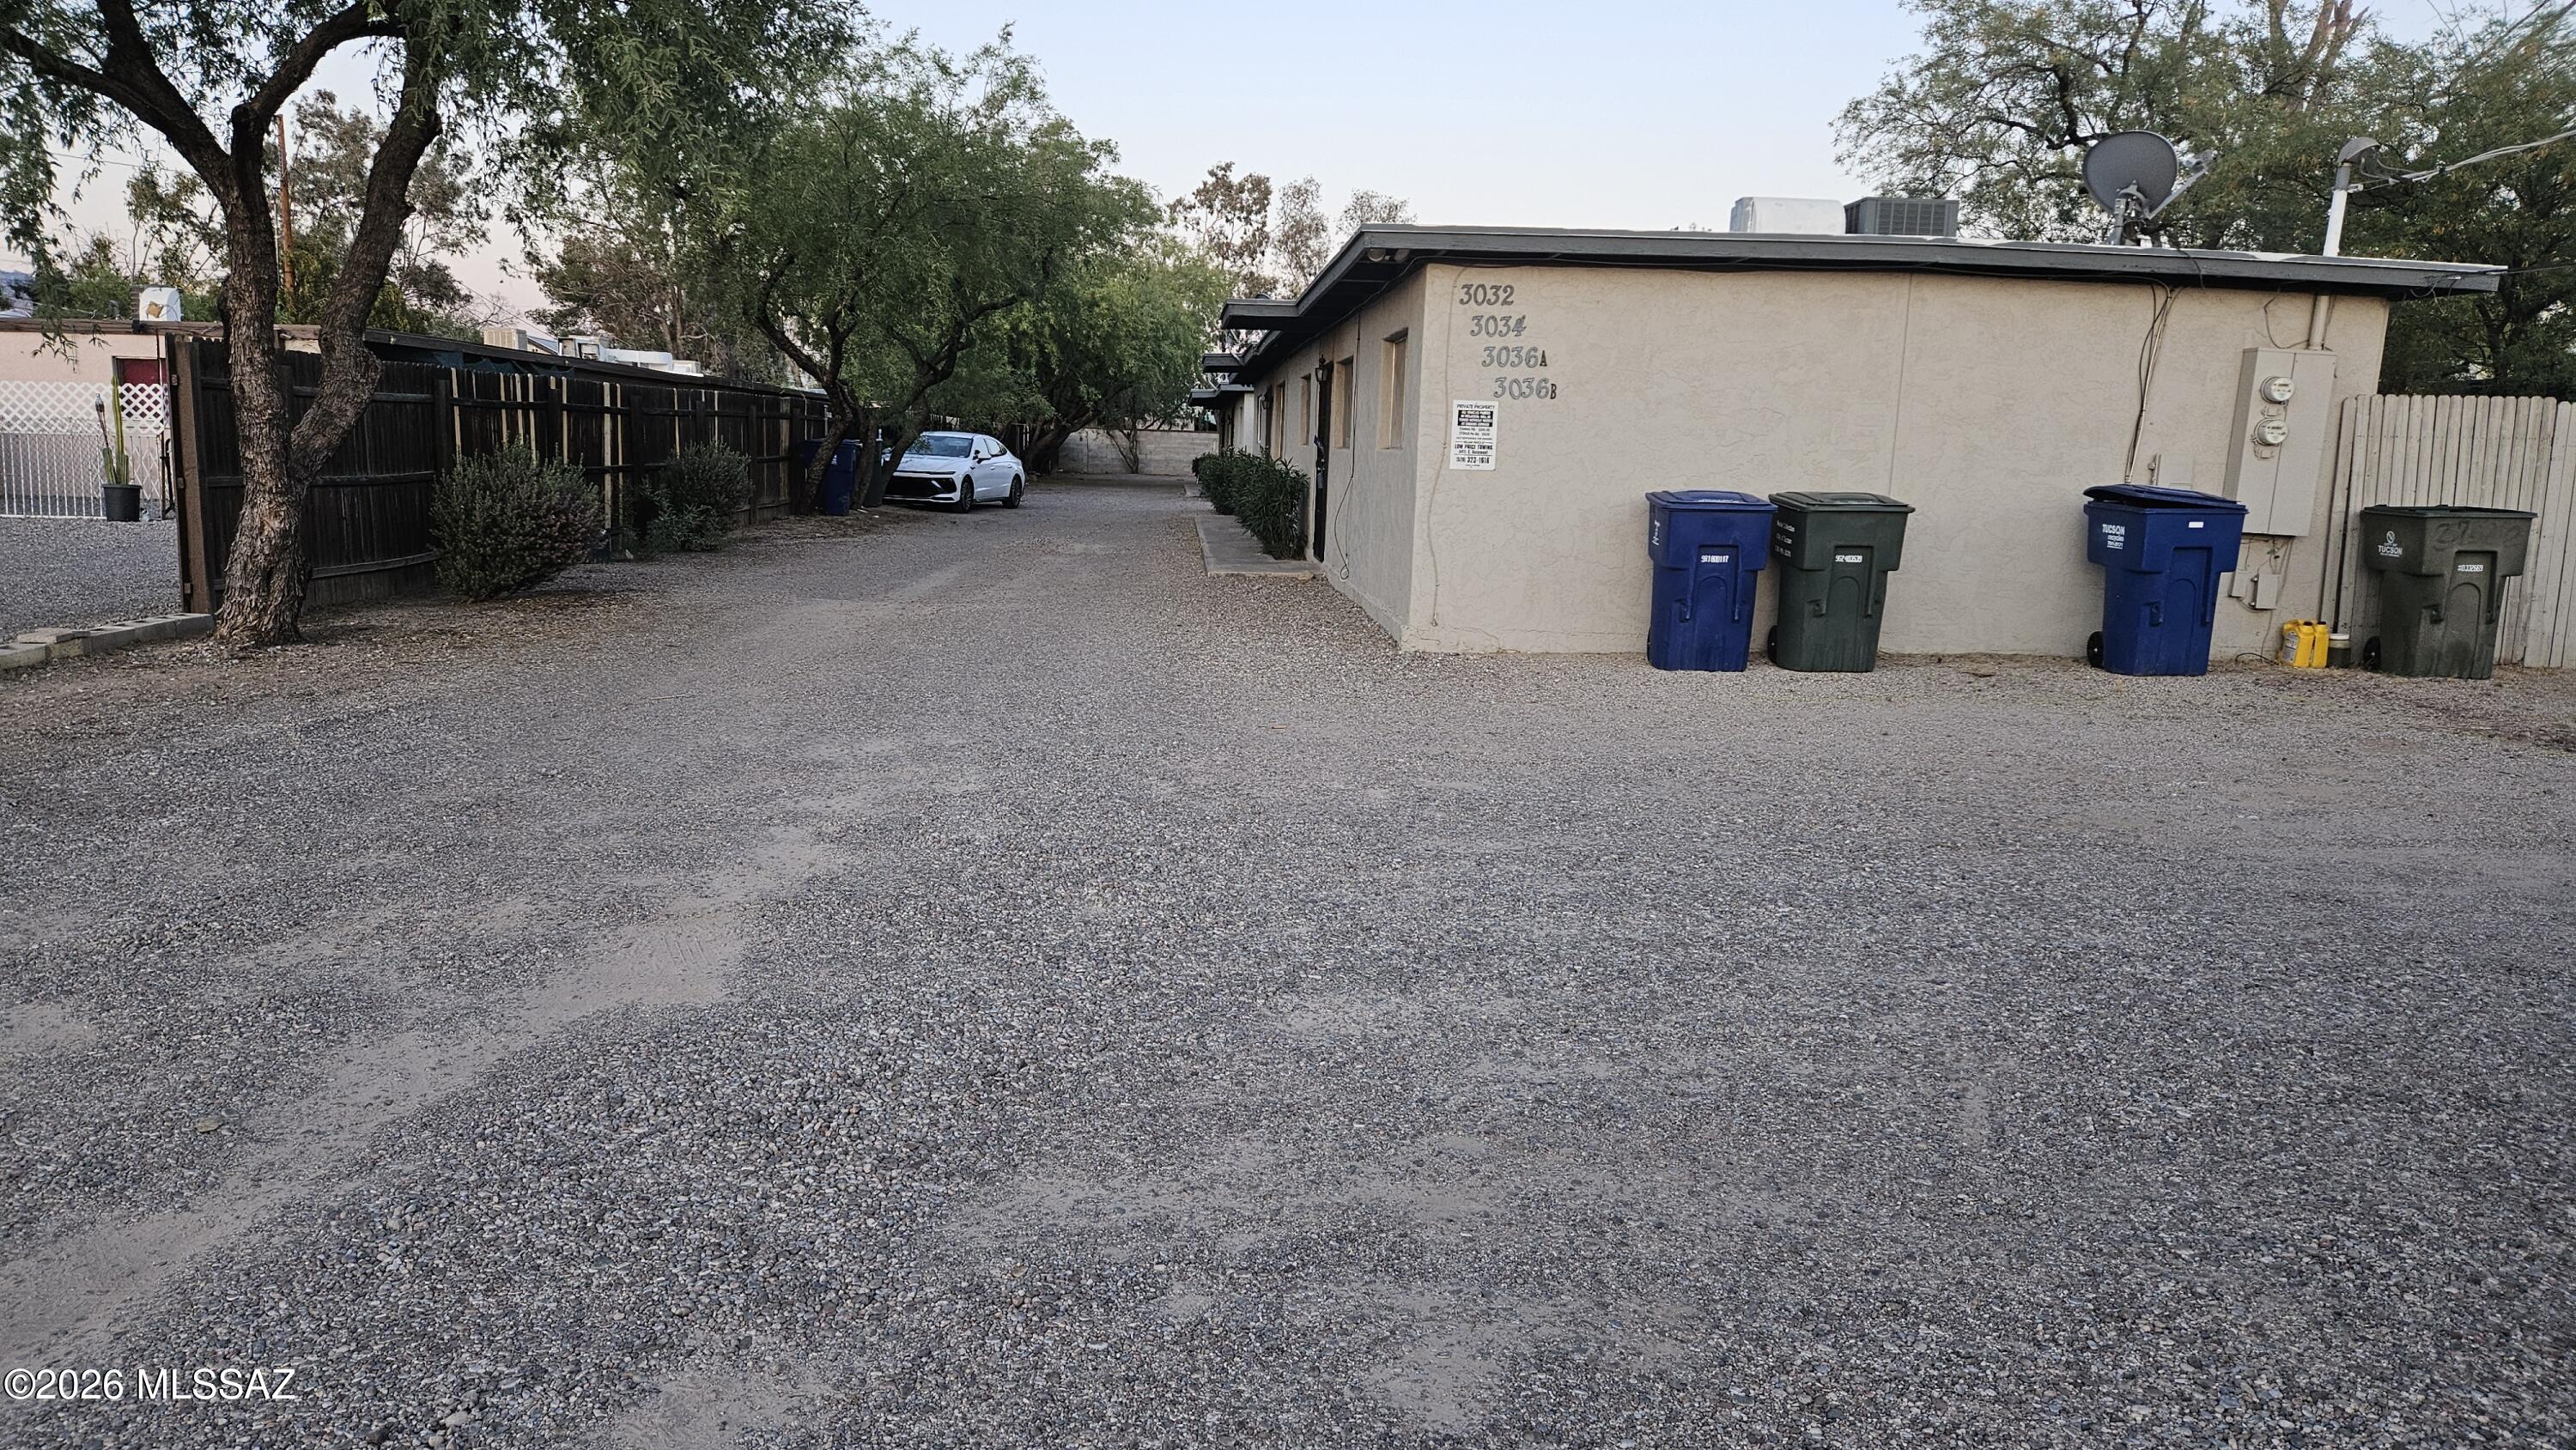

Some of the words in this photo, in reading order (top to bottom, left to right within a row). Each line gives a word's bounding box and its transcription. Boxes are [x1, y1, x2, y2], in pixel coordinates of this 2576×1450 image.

[1459, 283, 1515, 306] 3032
[1470, 315, 1527, 337] 3034
[2102, 524, 2125, 535] TUCSON
[2378, 545, 2403, 555] TUCSON
